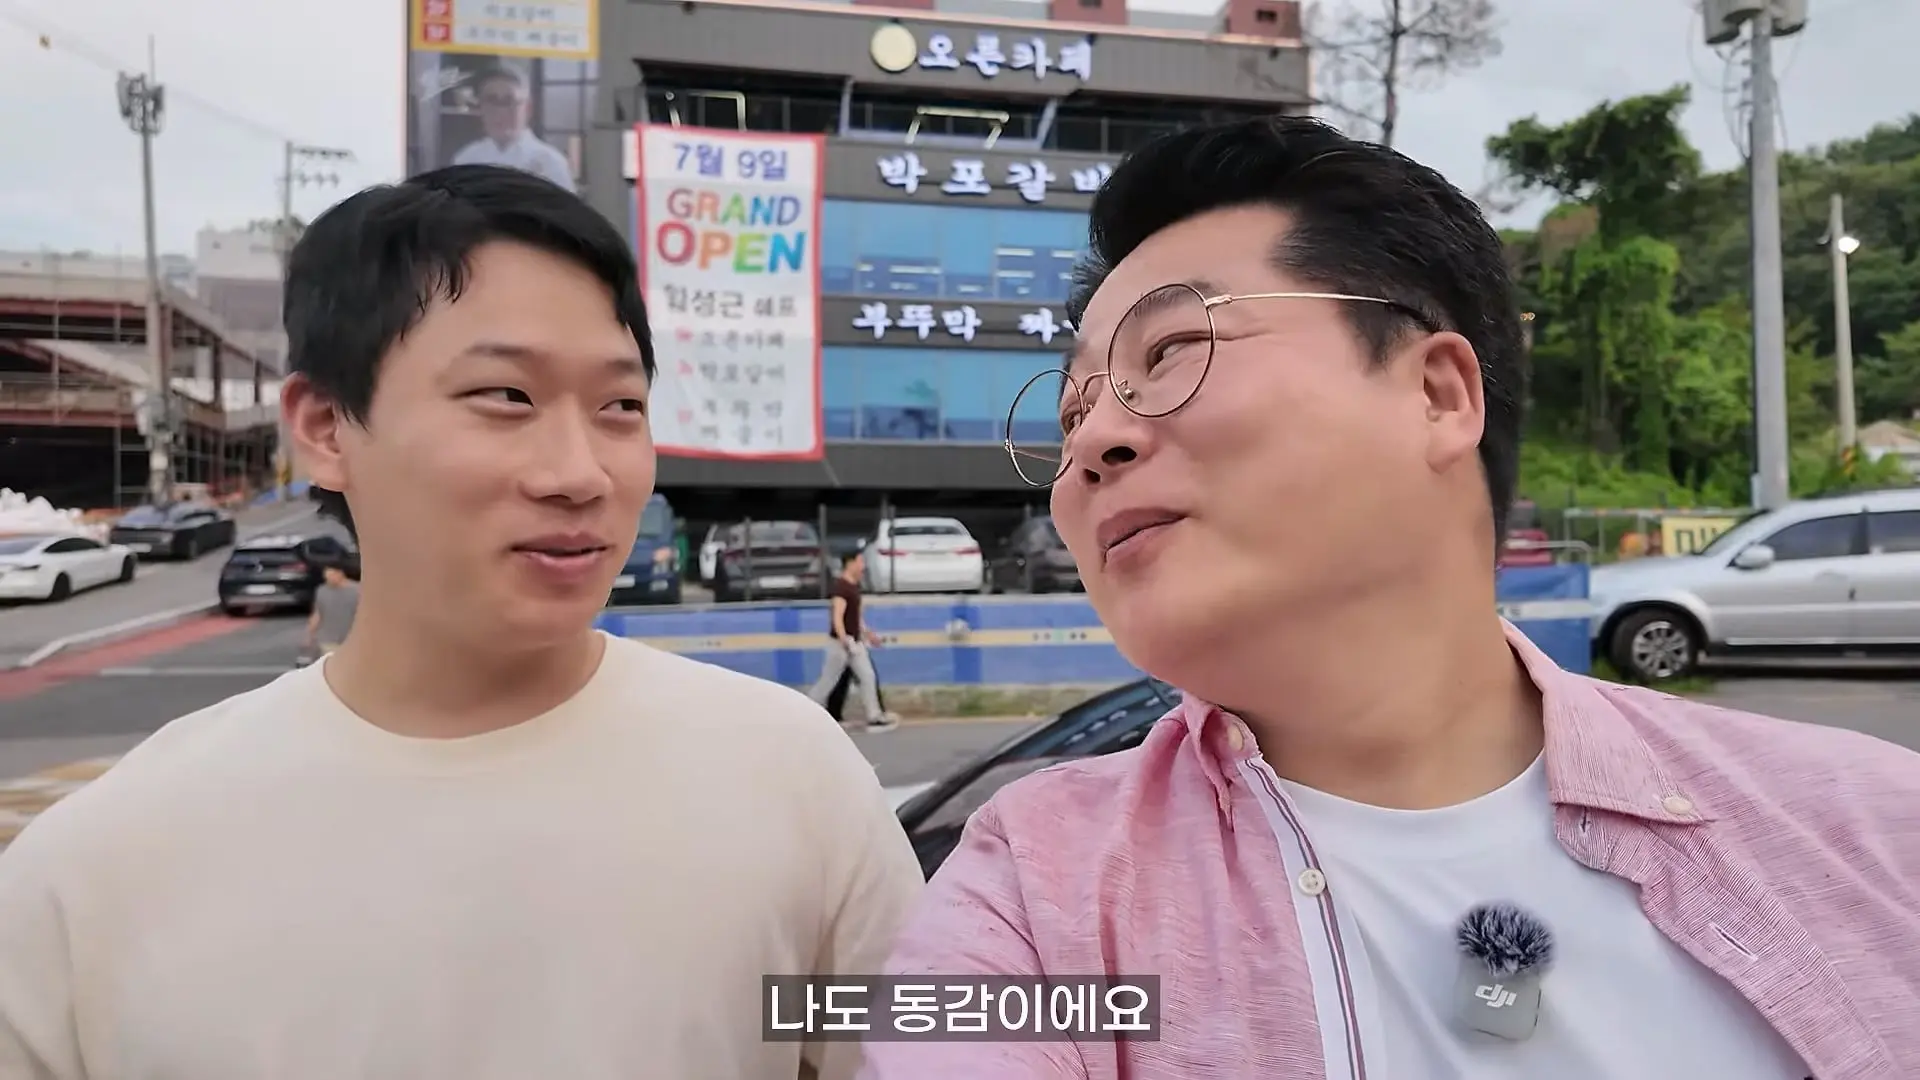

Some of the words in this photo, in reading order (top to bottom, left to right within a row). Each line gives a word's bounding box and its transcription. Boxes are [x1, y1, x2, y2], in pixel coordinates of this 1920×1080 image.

[674, 143, 723, 177] 7월
[737, 150, 787, 181] 9일
[667, 188, 802, 226] GRAND
[657, 221, 806, 274] OPEN
[852, 302, 982, 342] 부뚜막
